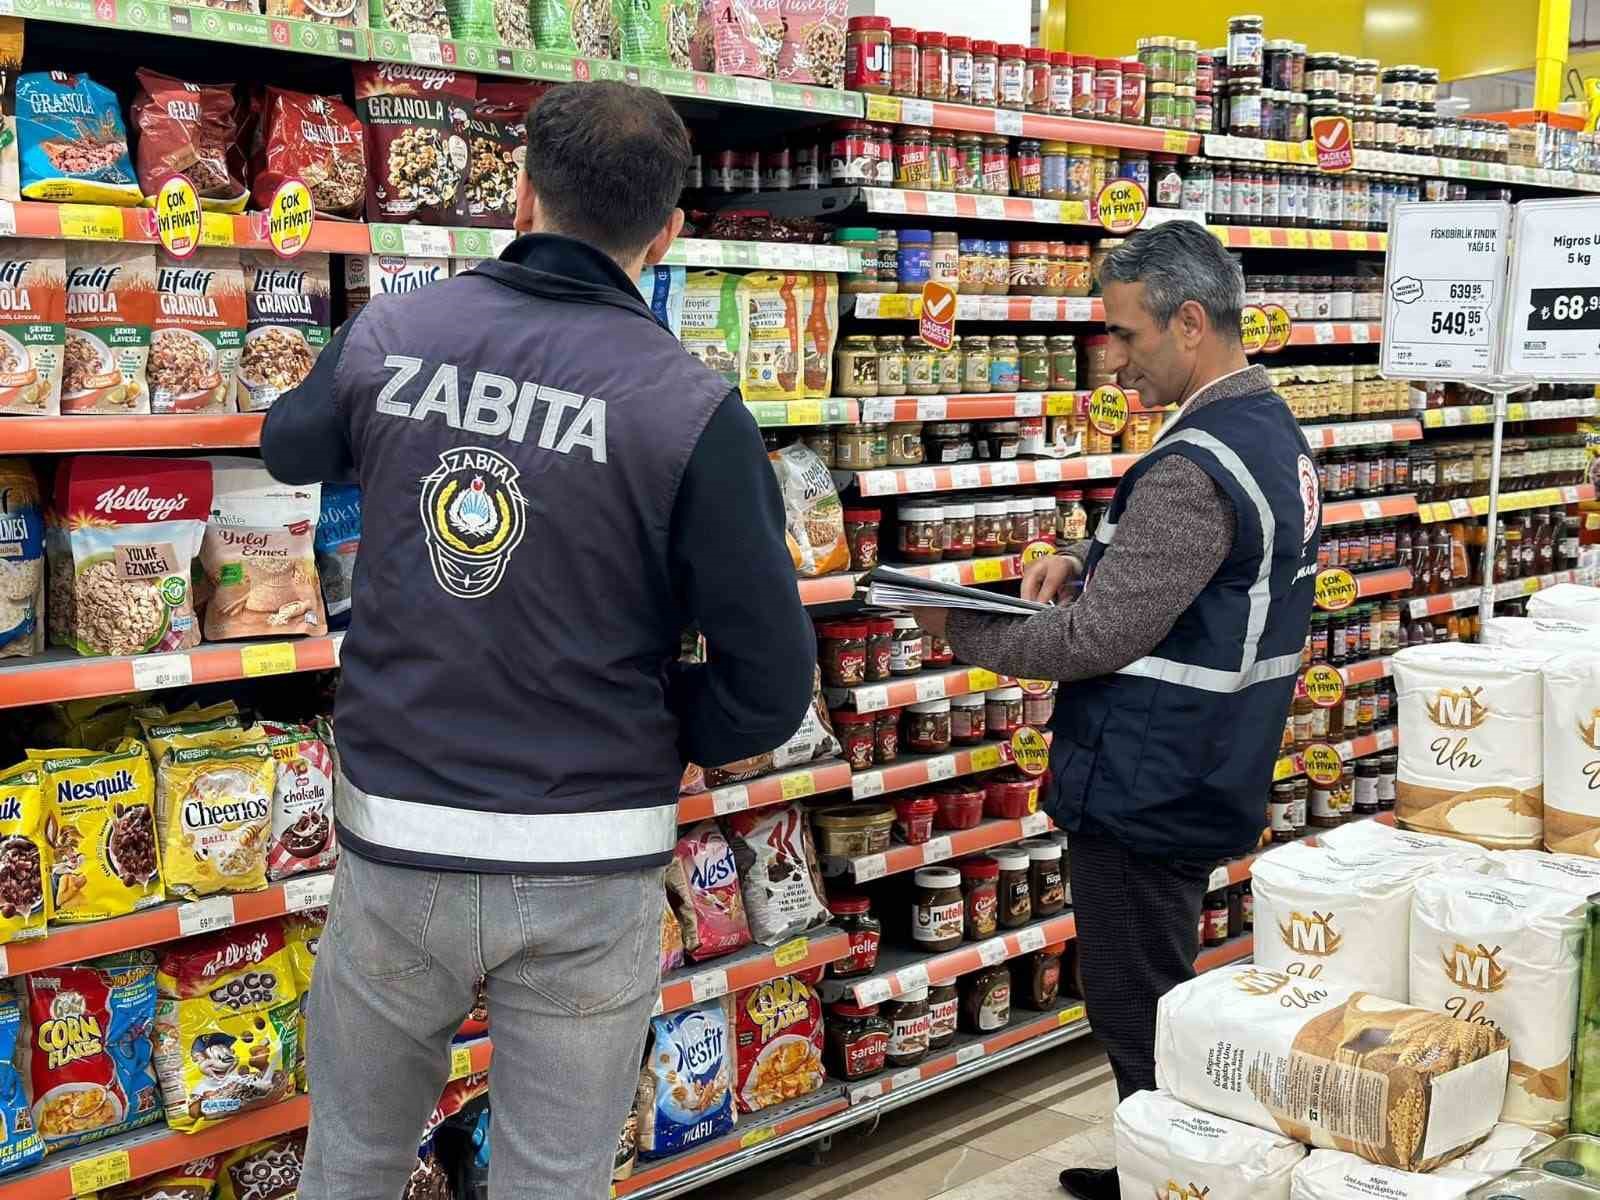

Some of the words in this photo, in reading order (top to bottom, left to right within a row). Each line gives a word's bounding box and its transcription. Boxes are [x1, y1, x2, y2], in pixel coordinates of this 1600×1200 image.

[31, 91, 95, 116] GRANOLA
[368, 96, 444, 121] GRANOLA
[301, 119, 354, 145] GRANOLA
[472, 119, 500, 138] OLA
[167, 191, 186, 212] ÇOK
[281, 193, 300, 214] ÇOK
[158, 213, 170, 232] İYİ
[171, 210, 199, 230] FİYAT!
[270, 215, 282, 234] İYİ
[284, 210, 312, 231] FİYAT!
[1431, 228, 1472, 239] FİSKOBİRLİK
[1473, 229, 1497, 239] FINDIK
[1553, 234, 1591, 249] Migros
[1567, 253, 1575, 263] 5
[1577, 252, 1591, 265] kg
[157, 269, 216, 295] Lifalif
[254, 269, 308, 295] Lifalif
[160, 294, 219, 317] GRANOLA
[256, 295, 312, 315] GRANOLA
[376, 355, 607, 463] ZABITA
[447, 453, 509, 483] ZABITA
[95, 484, 188, 521] Kellogg's
[218, 531, 272, 548] Yulaf
[242, 546, 289, 557] Ezmesi
[125, 547, 158, 563] YULAF
[125, 560, 169, 576] EZMESİ
[1438, 695, 1473, 726] M
[1430, 736, 1483, 772] Un
[57, 770, 134, 803] Nesquik
[283, 786, 325, 804] chokella
[185, 798, 268, 829] Cheerios
[1292, 923, 1327, 953] M
[1455, 950, 1490, 988] M
[209, 971, 277, 1003] COCO
[1280, 986, 1328, 1010] Un
[226, 989, 273, 1010] POPS
[38, 1015, 103, 1053] CORN
[47, 1038, 104, 1071] FLAKES
[674, 1023, 725, 1074] Nesfit
[850, 1040, 888, 1061] sarelle
